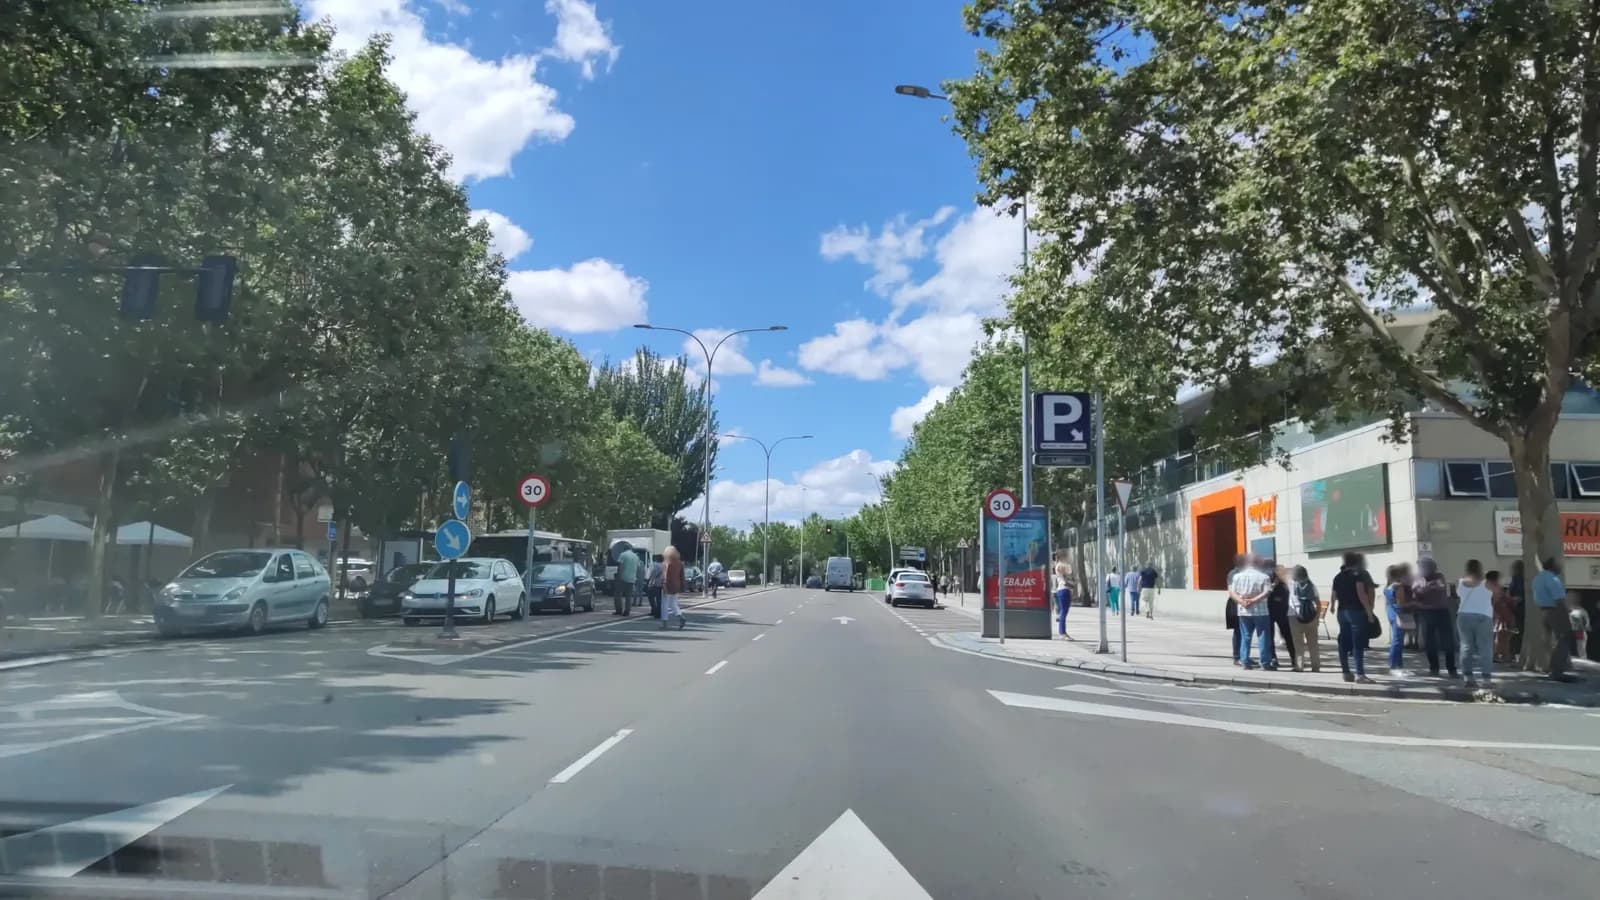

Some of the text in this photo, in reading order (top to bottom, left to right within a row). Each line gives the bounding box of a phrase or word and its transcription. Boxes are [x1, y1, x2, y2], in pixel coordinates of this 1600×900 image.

[1043, 395, 1082, 441] P
[524, 485, 542, 496] 30
[993, 500, 1011, 511] 30
[998, 577, 1037, 586] EBAJAS
